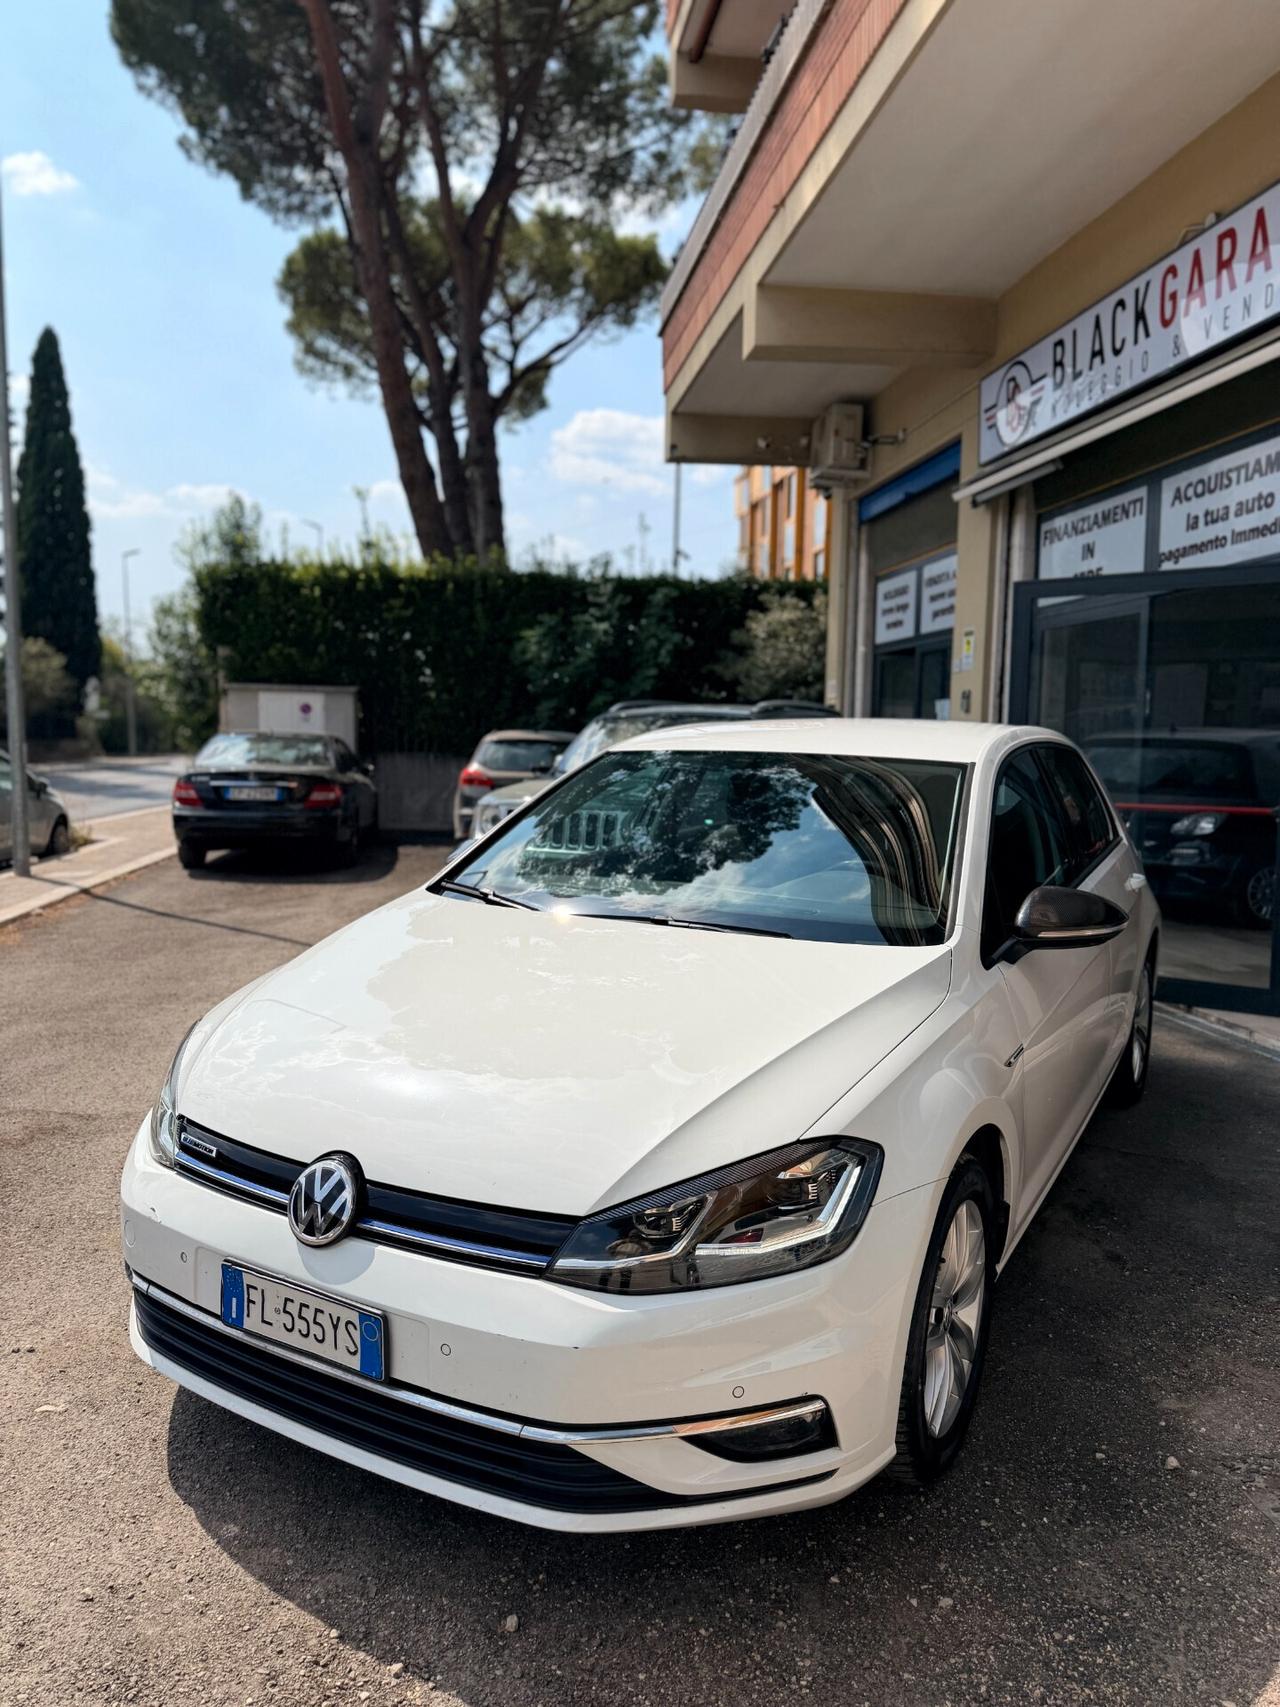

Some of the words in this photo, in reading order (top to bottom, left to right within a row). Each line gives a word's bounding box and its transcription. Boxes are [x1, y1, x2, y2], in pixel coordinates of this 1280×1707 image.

[1172, 334, 1181, 357] &
[1204, 282, 1274, 340] VEND
[1043, 496, 1144, 548] FINANZIAMENTI
[1185, 512, 1199, 533] la
[1203, 504, 1230, 527] tua
[1234, 491, 1276, 518] auto
[1081, 540, 1095, 561] IN
[1159, 535, 1228, 568] pagamento
